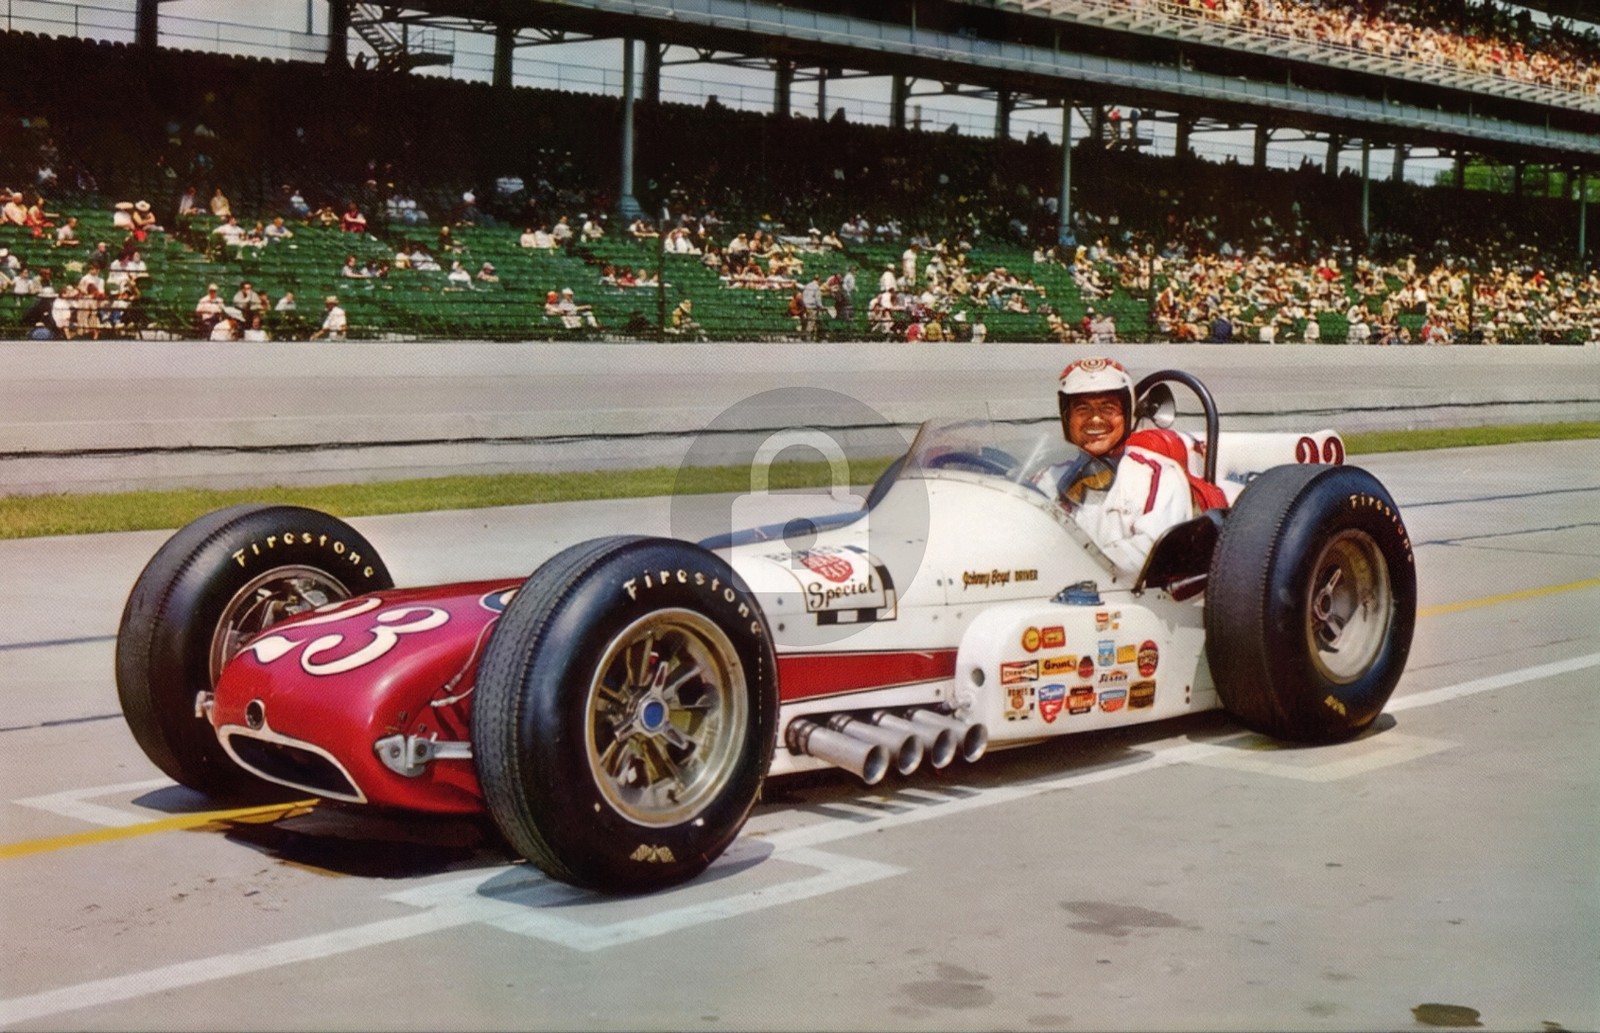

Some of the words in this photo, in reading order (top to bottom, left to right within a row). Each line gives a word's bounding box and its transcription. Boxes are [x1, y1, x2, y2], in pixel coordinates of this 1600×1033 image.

[1350, 491, 1414, 562] Firestone
[231, 531, 375, 579] Firestone
[622, 568, 763, 638] Firestone
[807, 574, 876, 609] Special
[963, 570, 990, 591] Johnny
[991, 568, 1010, 587] Boyd
[1014, 569, 1038, 582] DRIVER
